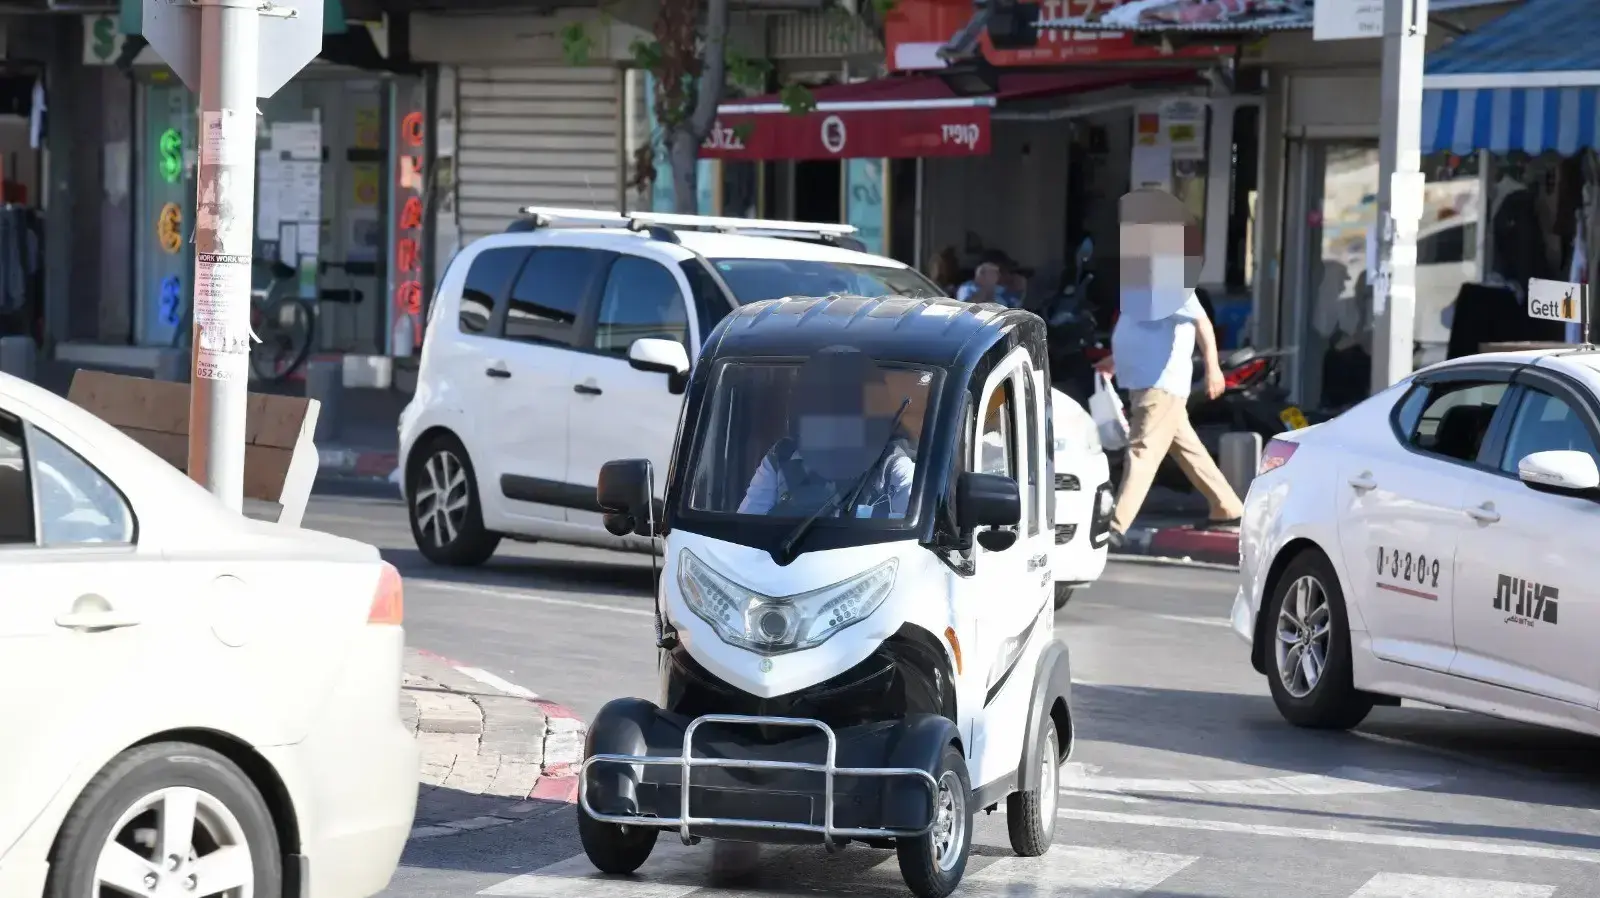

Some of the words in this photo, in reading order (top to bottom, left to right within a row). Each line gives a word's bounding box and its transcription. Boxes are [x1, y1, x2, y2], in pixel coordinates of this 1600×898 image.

[199, 254, 215, 262] WORK
[216, 255, 237, 263] WORK
[1531, 299, 1560, 318] Gett
